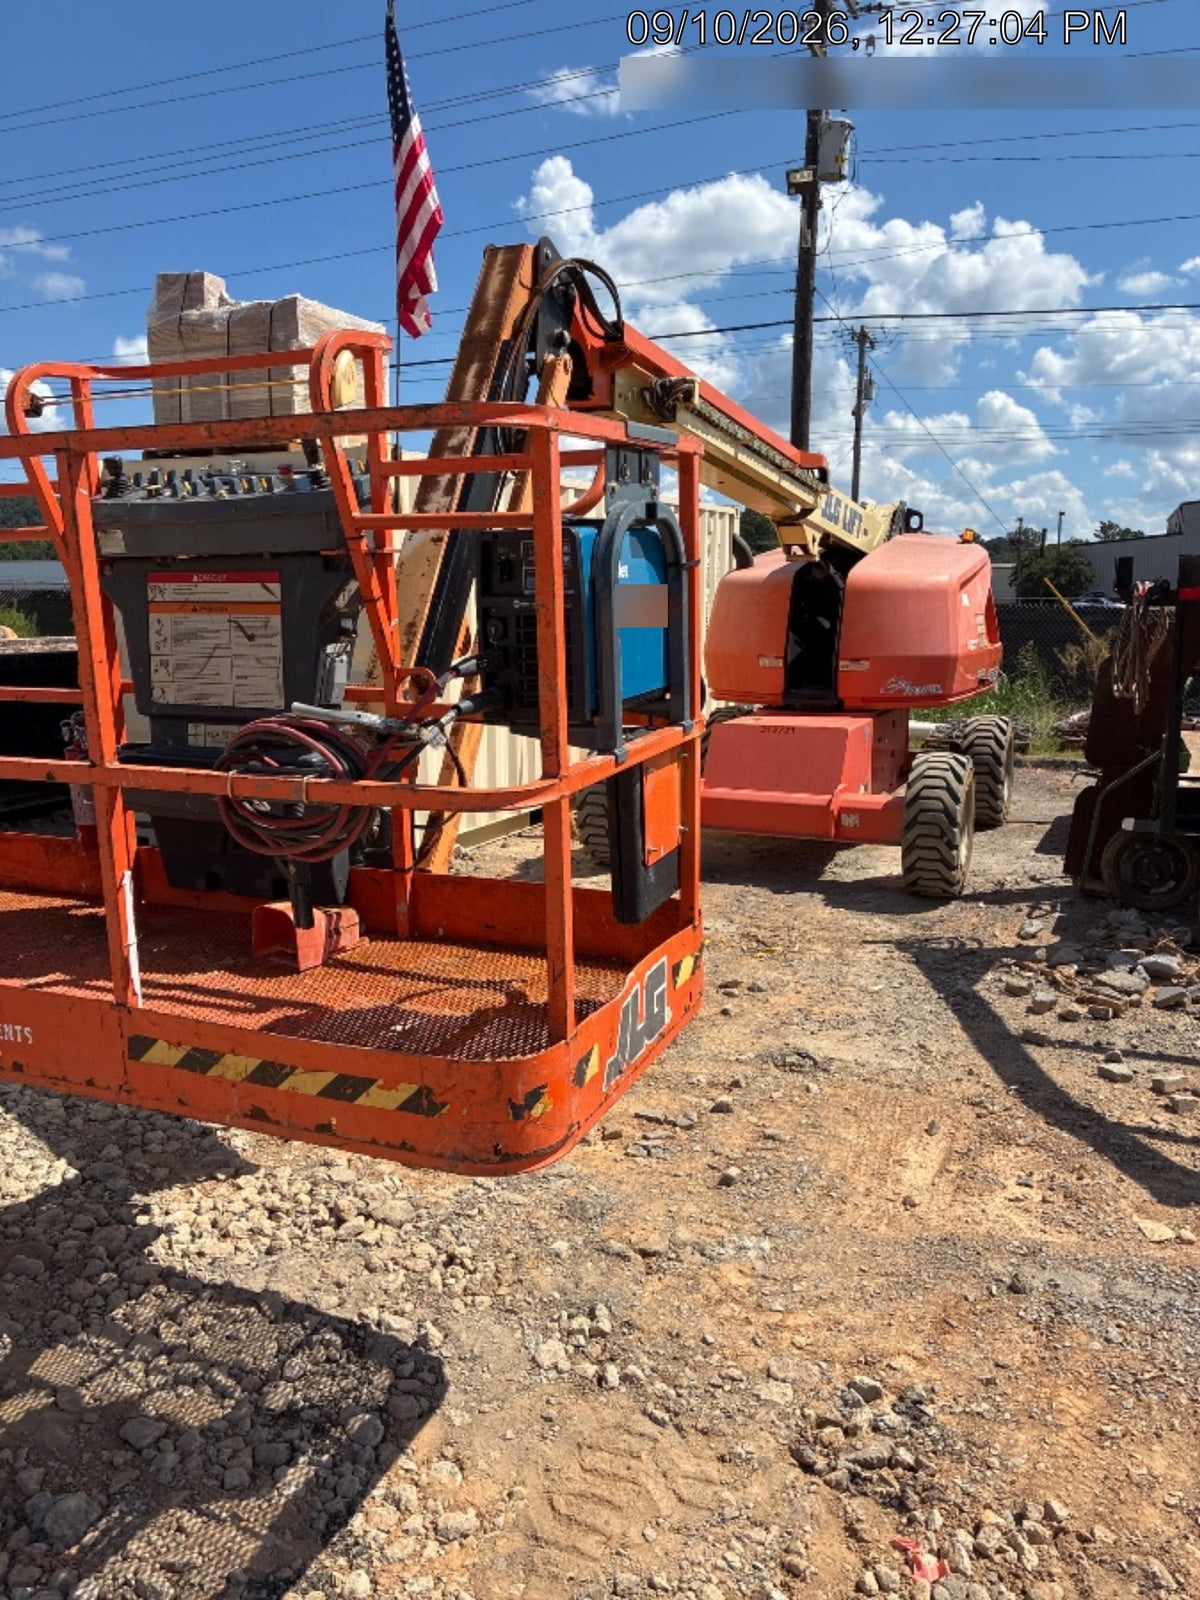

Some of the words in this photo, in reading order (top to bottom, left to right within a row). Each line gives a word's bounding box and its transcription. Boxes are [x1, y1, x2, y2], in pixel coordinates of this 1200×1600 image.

[821, 493, 841, 526] JLG
[843, 503, 863, 540] LIFT
[602, 955, 668, 1092] JLG
